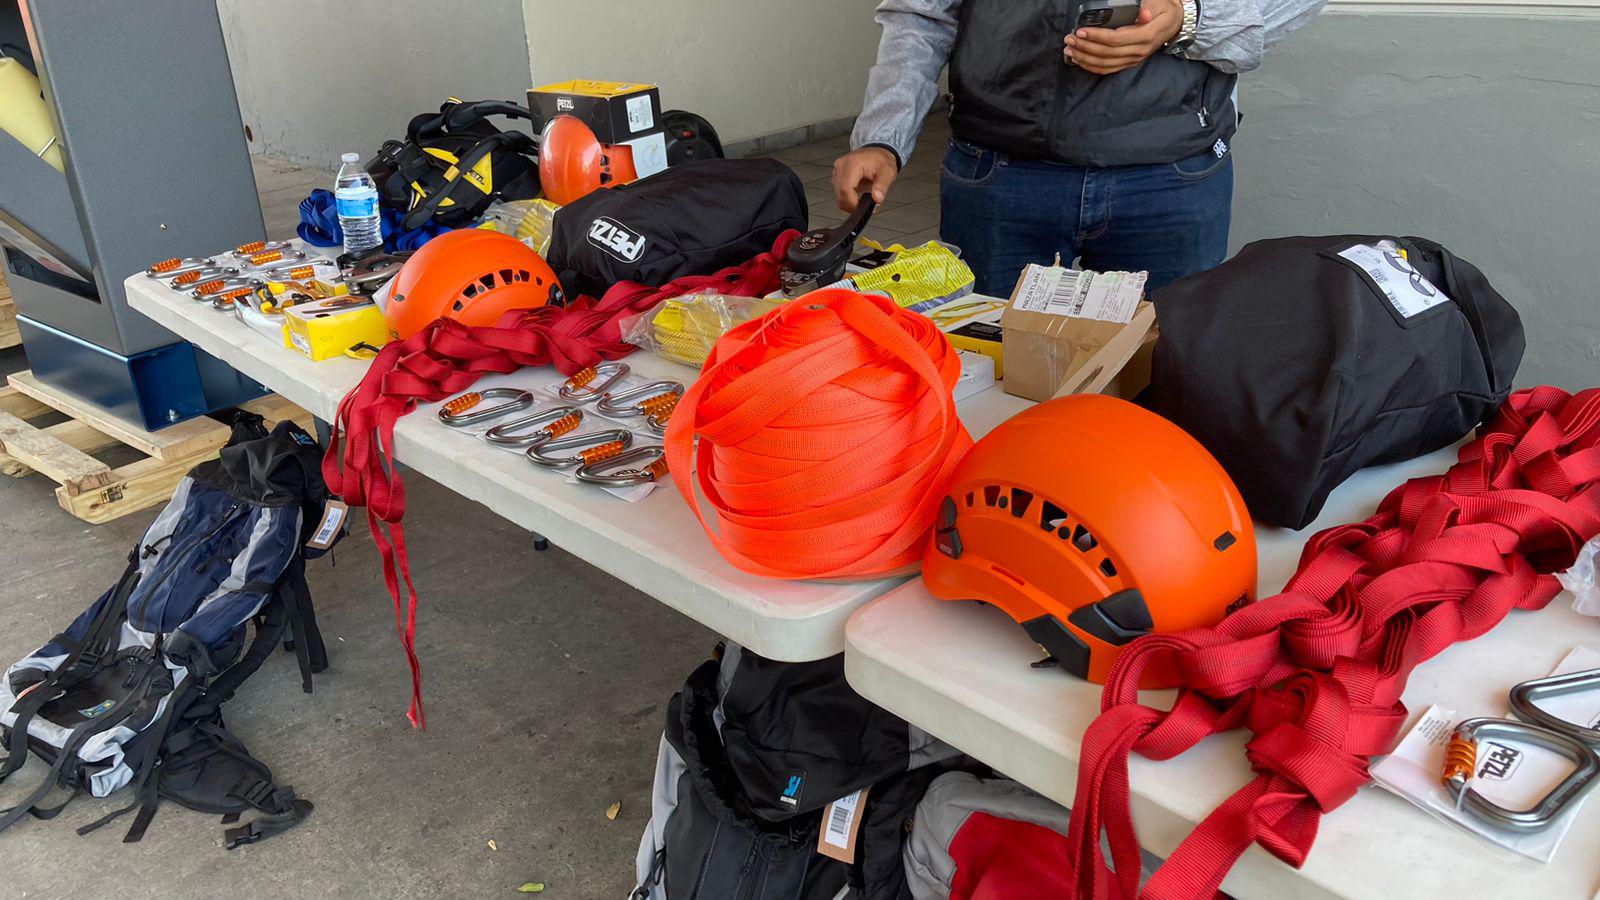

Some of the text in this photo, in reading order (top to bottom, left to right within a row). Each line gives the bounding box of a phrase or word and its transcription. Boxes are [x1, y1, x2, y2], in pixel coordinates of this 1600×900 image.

[557, 98, 574, 111] PETZL
[590, 219, 646, 261] PETZL
[1478, 741, 1519, 779] PETZL
